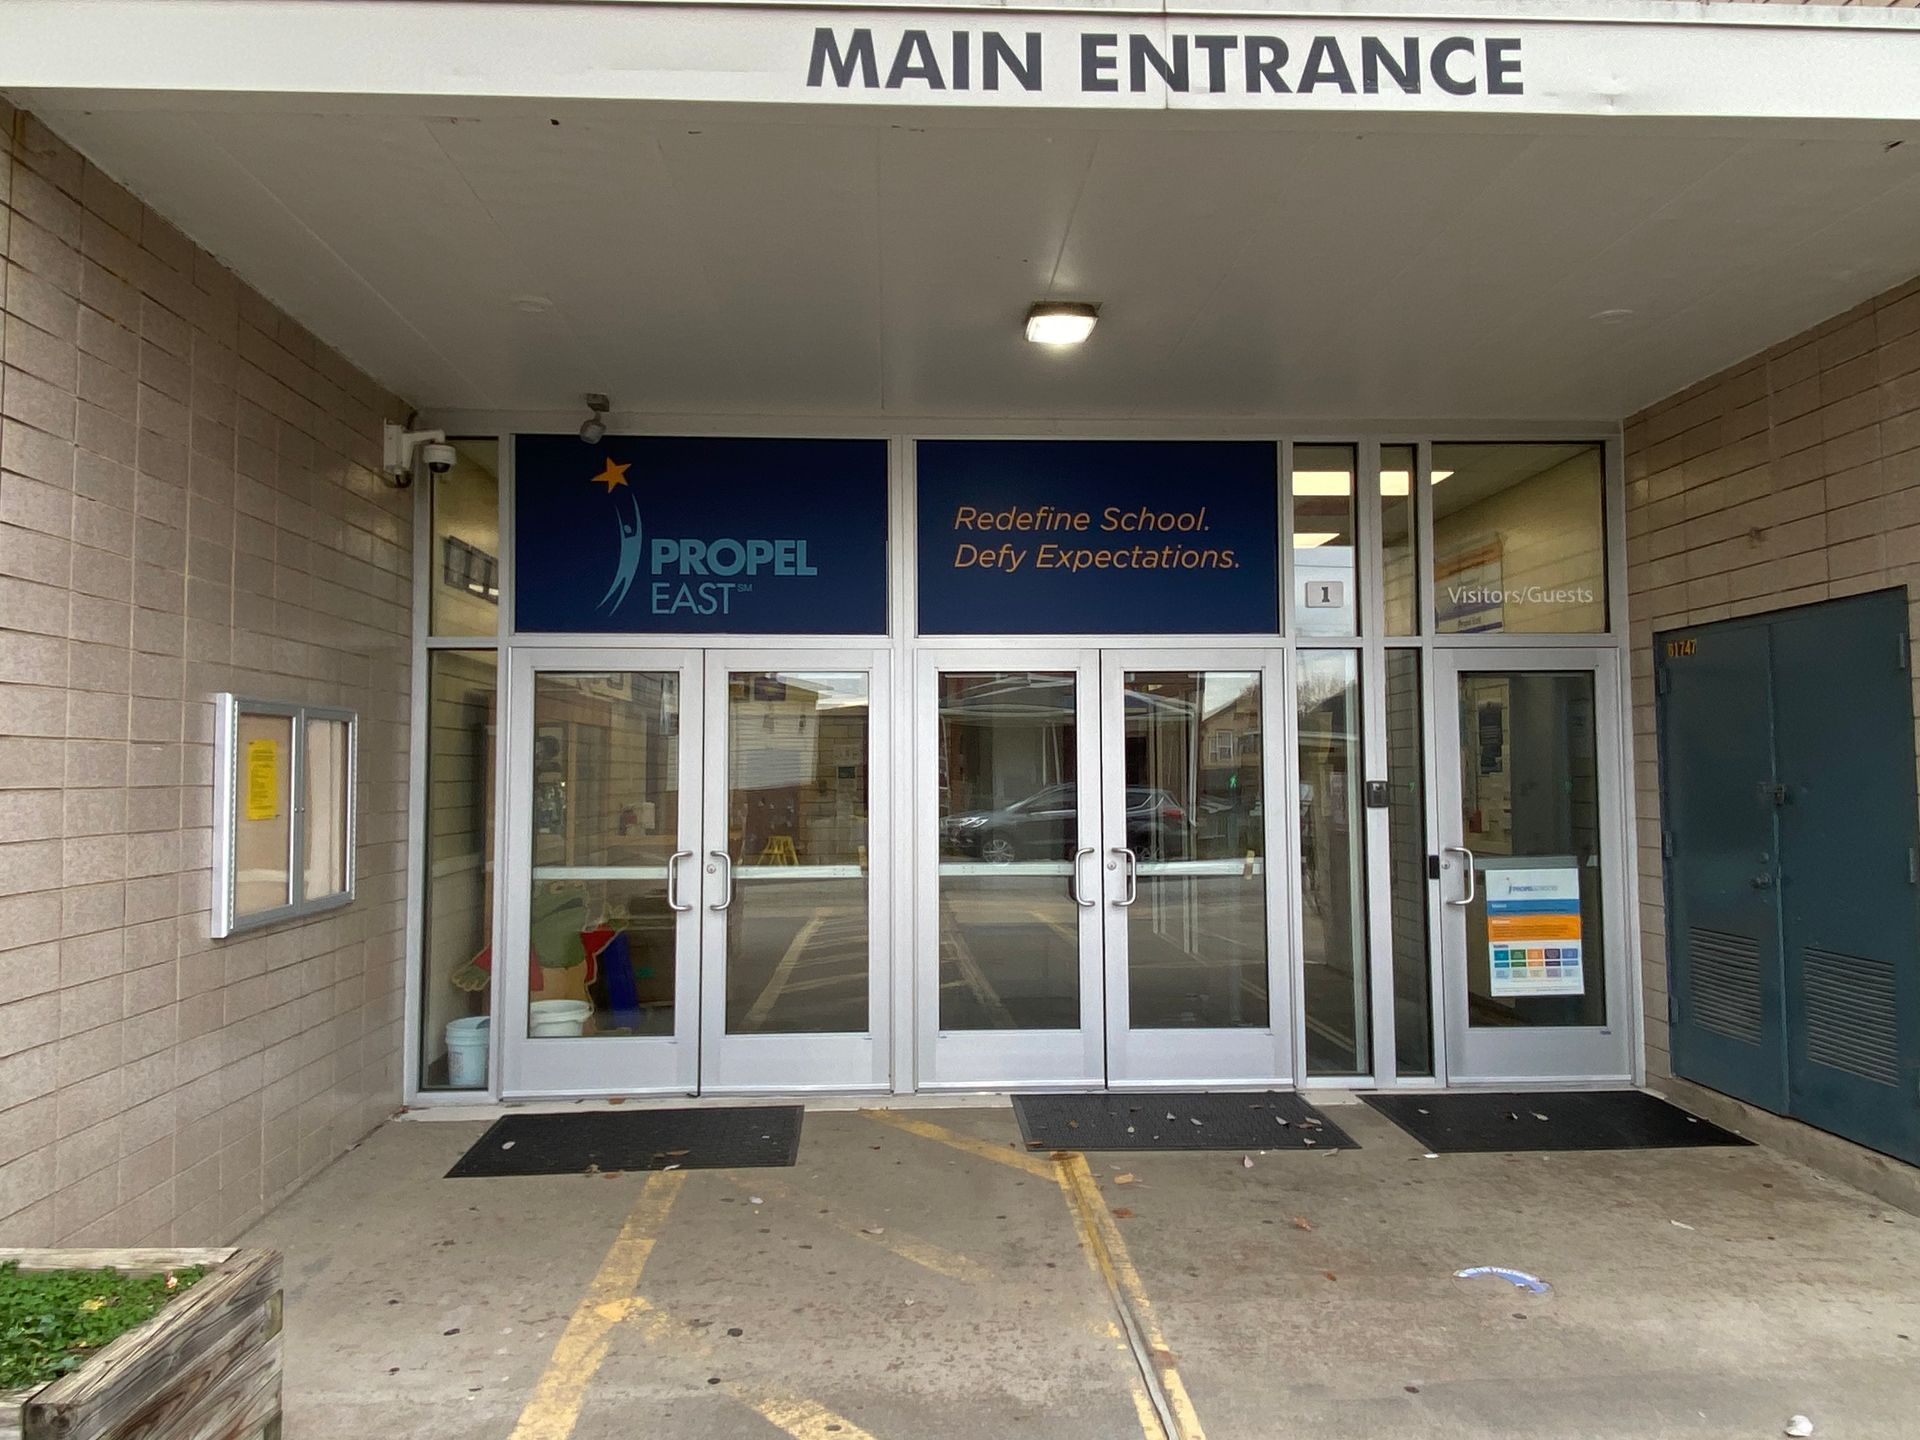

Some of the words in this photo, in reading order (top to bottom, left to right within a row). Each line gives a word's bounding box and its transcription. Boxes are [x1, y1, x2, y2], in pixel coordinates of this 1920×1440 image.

[806, 27, 1042, 92] MAIN
[1080, 33, 1525, 96] ENTRANCE
[954, 506, 1091, 531] Redefine
[1100, 506, 1210, 531] School.
[651, 538, 818, 576] PROPEL
[954, 543, 1027, 573] Defy
[1036, 544, 1240, 573] Expectations.
[652, 582, 737, 615] EAST
[1321, 586, 1330, 603] 1
[1447, 586, 1594, 605] Visitors/Guests
